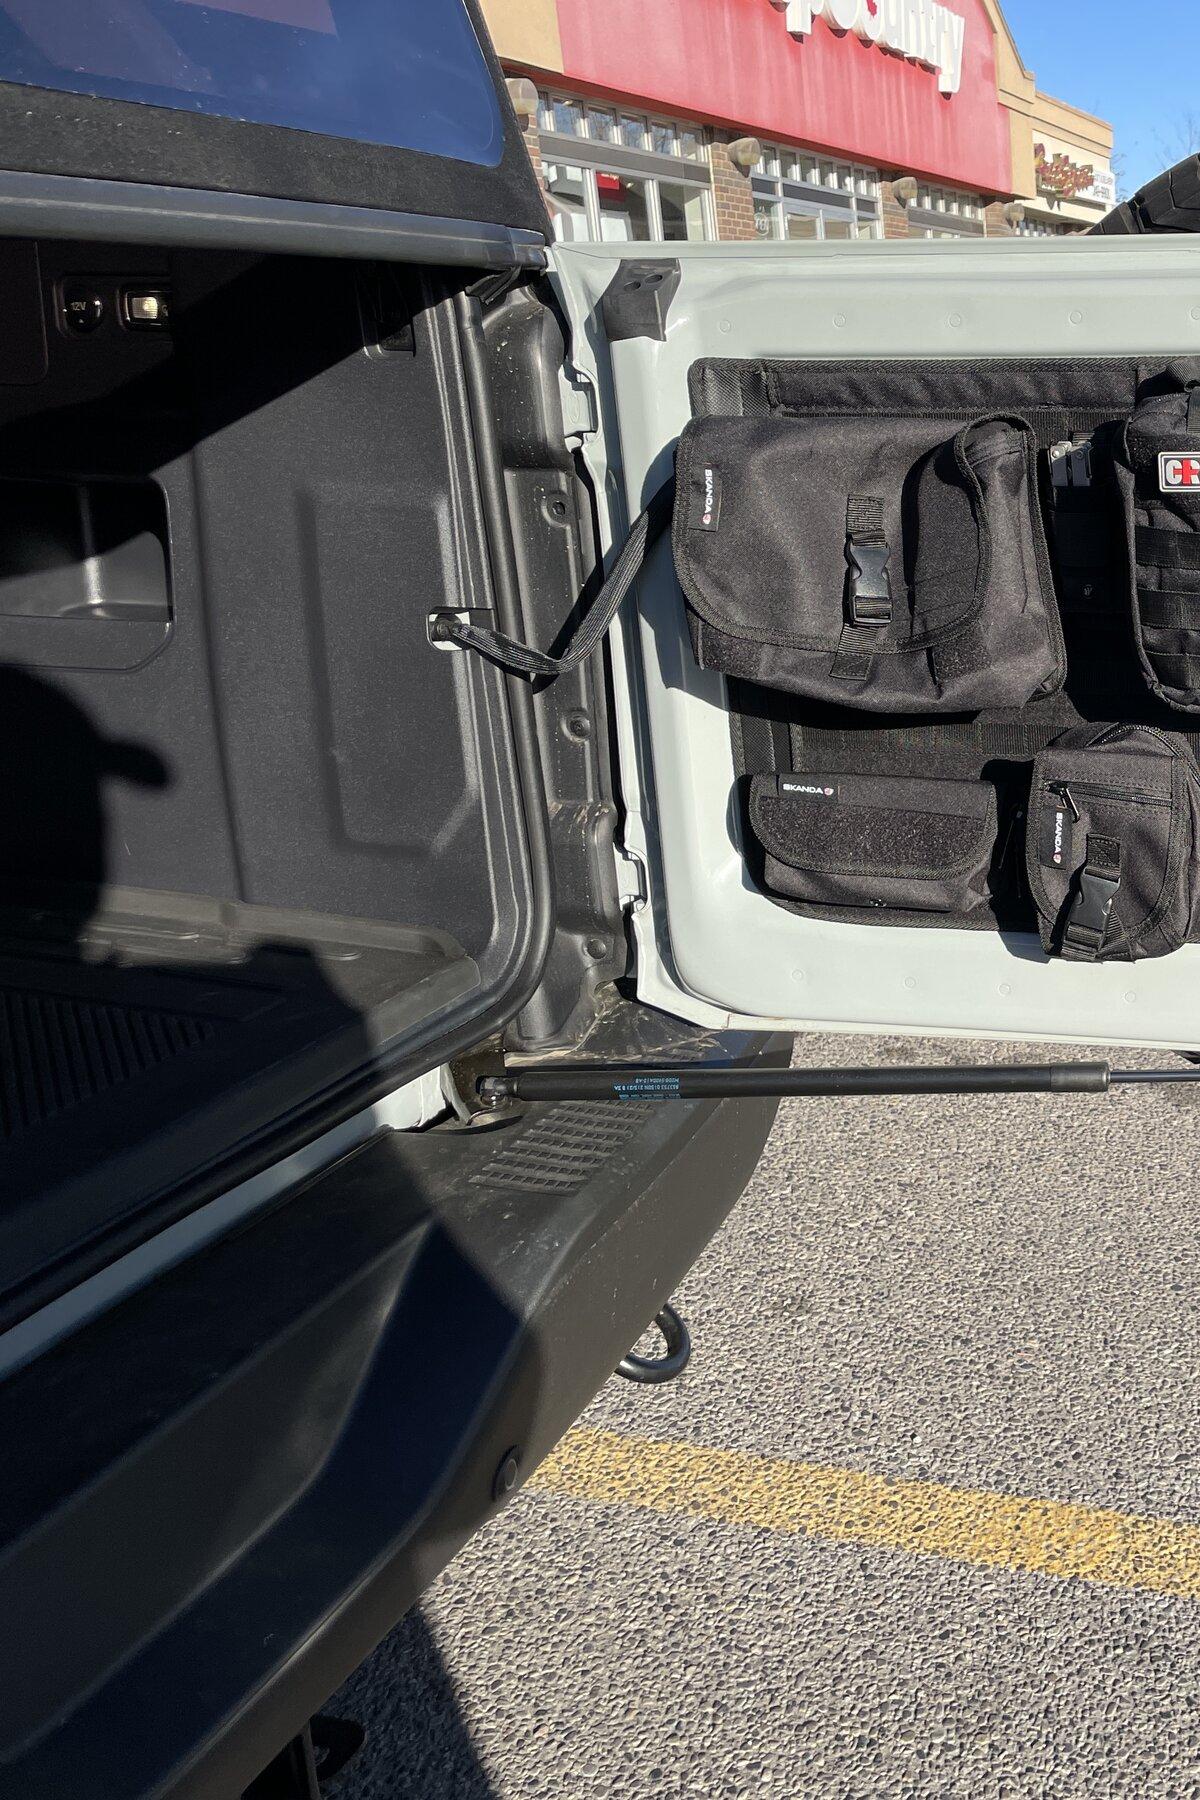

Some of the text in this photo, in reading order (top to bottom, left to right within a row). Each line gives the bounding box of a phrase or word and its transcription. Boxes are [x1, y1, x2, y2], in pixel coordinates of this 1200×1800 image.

[70, 301, 87, 311] 12V
[704, 469, 713, 514] SKANDA
[783, 783, 824, 794] SKANDA
[1055, 812, 1063, 853] SKANDA
